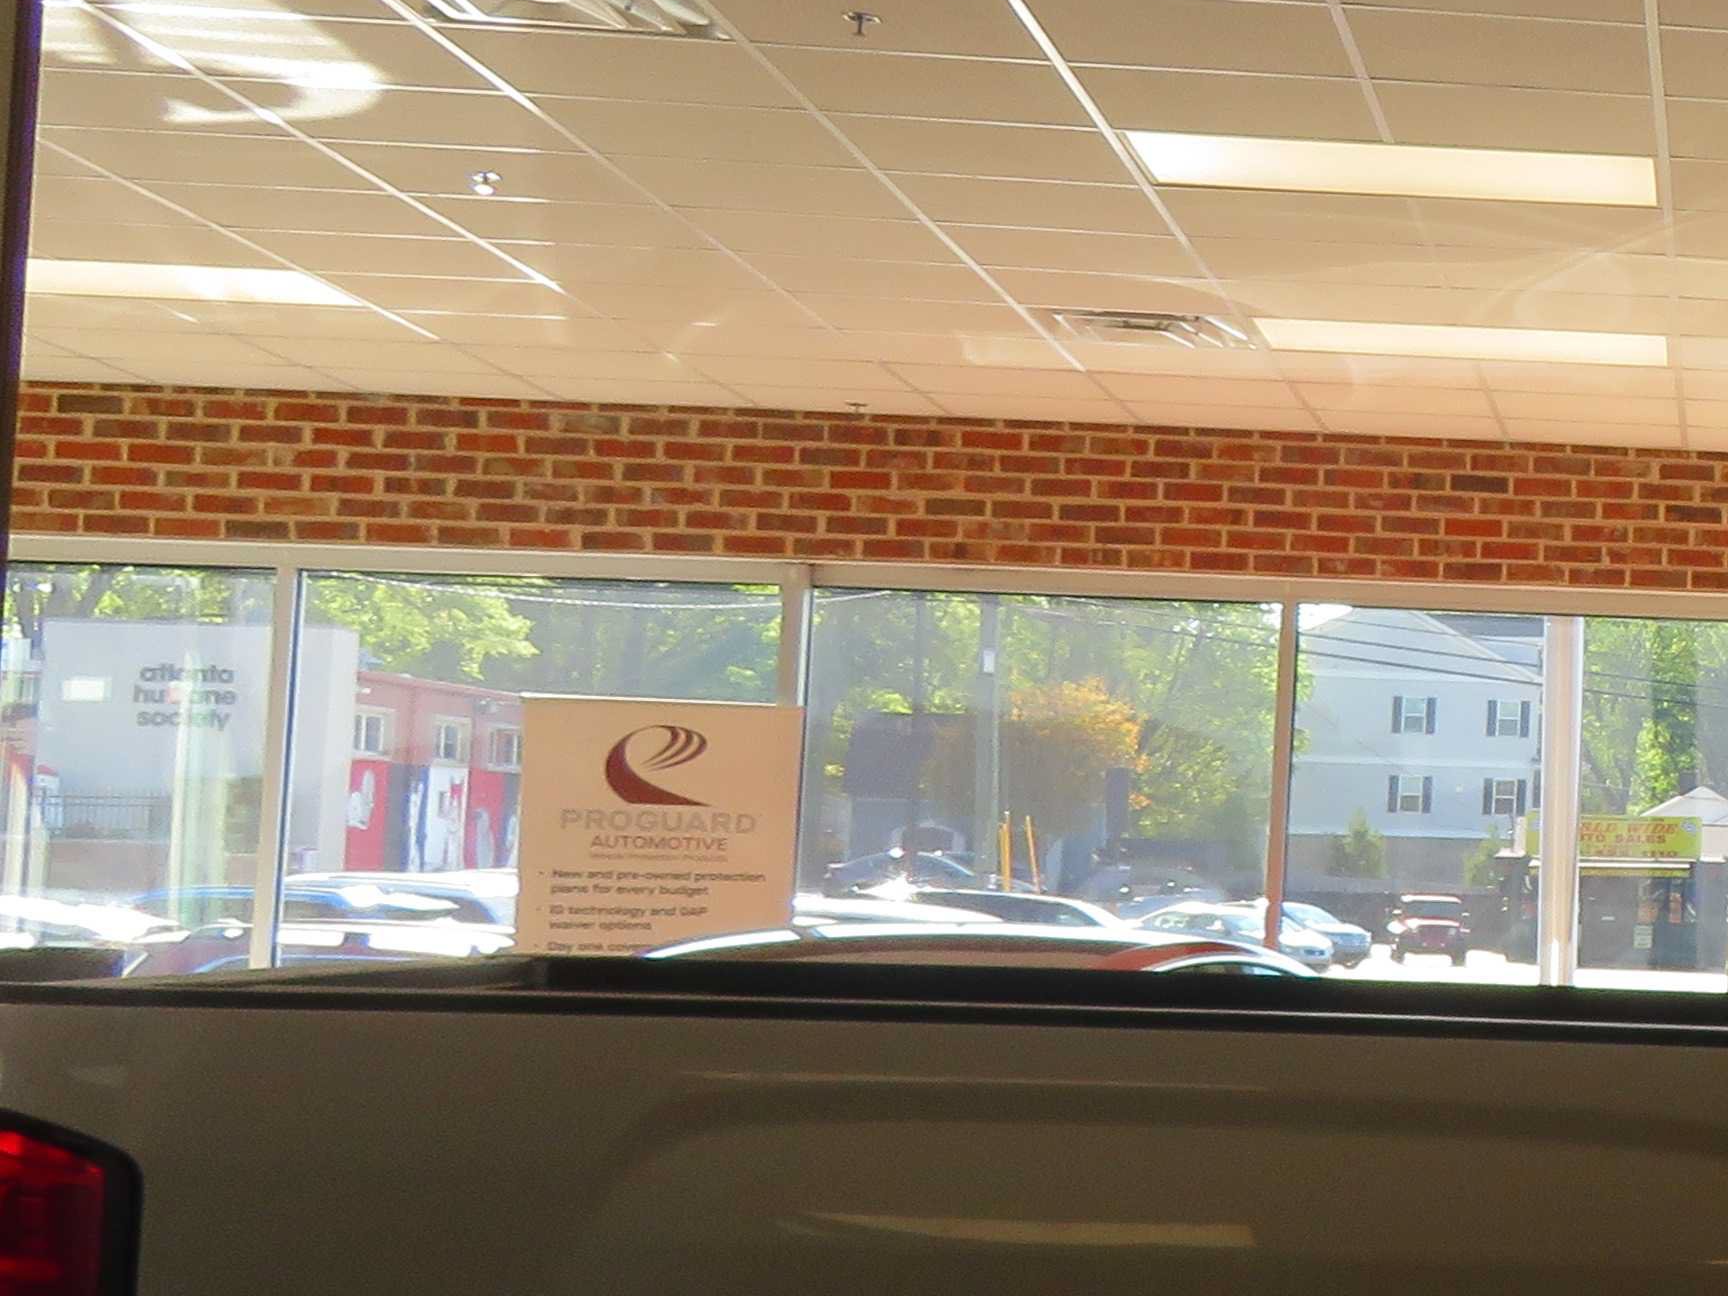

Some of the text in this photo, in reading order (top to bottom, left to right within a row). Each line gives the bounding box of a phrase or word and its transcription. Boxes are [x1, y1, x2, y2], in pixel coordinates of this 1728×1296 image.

[139, 663, 234, 683] atlanta
[559, 808, 757, 834] PROGUARD
[1627, 822, 1679, 834] WIDE
[590, 835, 728, 852] AUTOMOTIVE
[1615, 833, 1667, 844] SALES
[587, 870, 613, 880] and
[694, 872, 765, 883] protection
[551, 884, 709, 897] plans for every budget
[568, 905, 646, 918] technology
[651, 906, 677, 916] and
[599, 920, 652, 932] options
